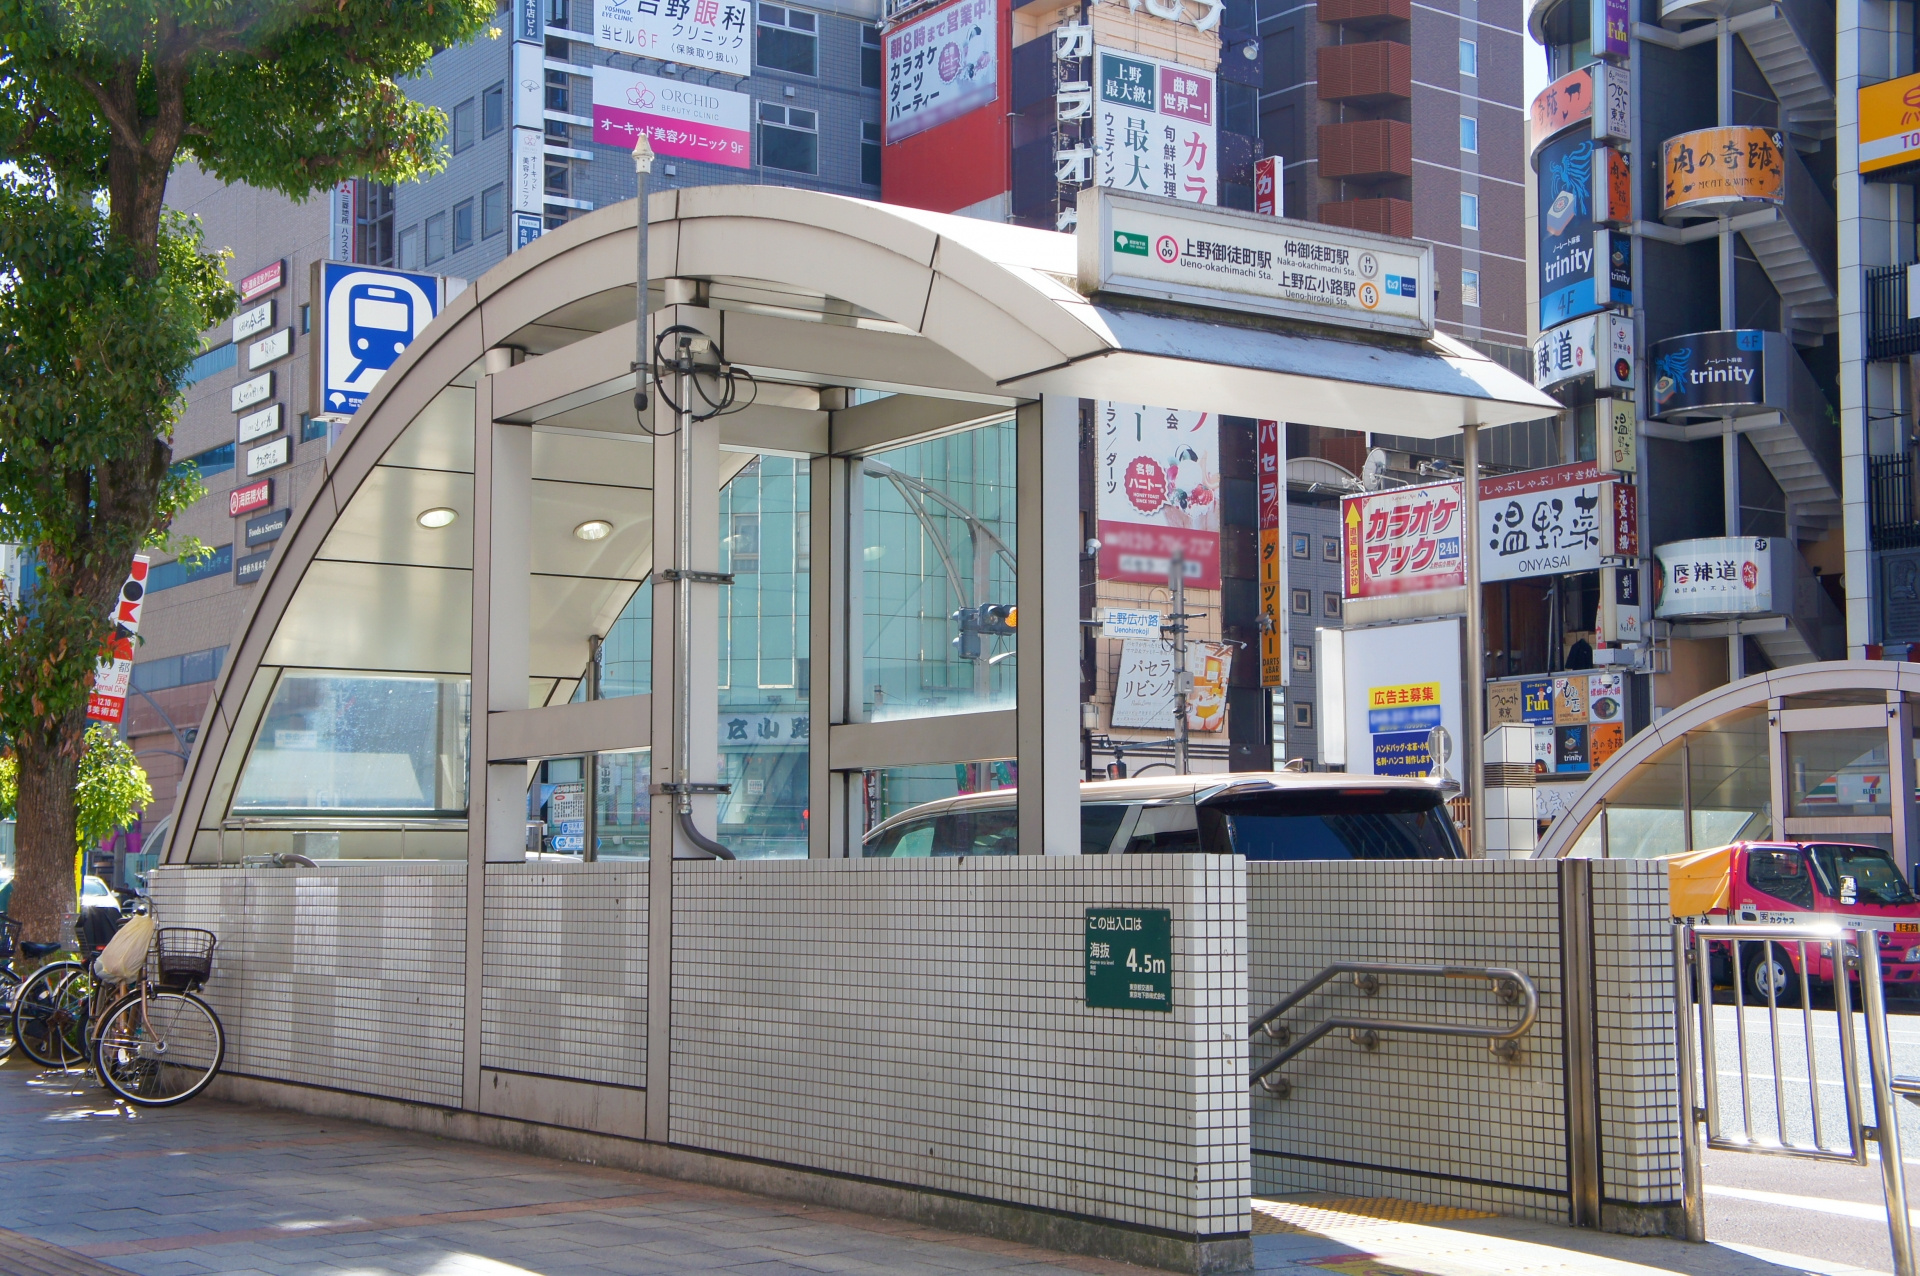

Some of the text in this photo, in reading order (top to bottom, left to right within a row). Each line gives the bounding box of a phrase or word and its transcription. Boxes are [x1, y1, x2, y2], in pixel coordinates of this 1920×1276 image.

[602, 10, 633, 23] EYE CLINIC
[604, 5, 631, 16] YOSHINO
[672, 22, 743, 49] クリニック
[1608, 21, 1628, 43] Fun
[890, 46, 937, 82] カラオケ
[1115, 63, 1142, 84] 上野
[1608, 69, 1616, 81] 6F
[890, 71, 924, 102] ダーツ
[1173, 76, 1199, 98] 曲数
[661, 88, 720, 110] ORCHID
[890, 91, 940, 122] パーティー
[661, 104, 720, 121] BEAUTY CLINIC
[1610, 108, 1626, 123] 東京
[601, 118, 744, 154] オーキッド美容クリニック 9F
[1772, 132, 1784, 150] 5F
[1163, 125, 1177, 199] 旬鮮料理
[522, 156, 530, 207] 美容クリニック
[1698, 177, 1755, 189] MEAT & WINE
[1165, 240, 1170, 248] E
[1161, 248, 1173, 258] 09
[1181, 238, 1272, 270] 上野御徒町駅
[1284, 240, 1350, 266] 仲御徒町駅
[1365, 257, 1371, 265] H
[1180, 258, 1274, 281] Ueno-okachimachi Sta.
[1277, 257, 1357, 277] Naka-okachimachi Sta.
[1364, 265, 1374, 274] 17
[1545, 248, 1594, 283] trinity
[1278, 270, 1356, 298] 上野広小路駅
[1610, 271, 1631, 286] trinity
[1285, 289, 1350, 307] Ueno-hirokoji Sta.
[1364, 295, 1374, 304] 15
[1365, 287, 1372, 295] G
[1557, 289, 1576, 317] 4F
[1741, 335, 1759, 348] 4F
[1690, 365, 1755, 385] trinity
[1135, 462, 1155, 477] 名物
[1260, 422, 1277, 503] パセラ
[1128, 478, 1163, 491] ハニトー
[248, 525, 262, 538] Foods
[265, 521, 283, 531] Services
[1365, 498, 1459, 544] カラオケ
[1489, 487, 1599, 557] 温野菜
[1440, 542, 1459, 556] 24h
[1756, 540, 1766, 550] 3F
[1350, 527, 1359, 587] 直進 徒歩30秒
[1366, 537, 1438, 578] マック
[1519, 555, 1571, 573] ONYASAI
[1105, 612, 1159, 627] 上野広小路
[1113, 626, 1150, 636] Uenohirokoji
[1126, 659, 1171, 677] パセラ
[1262, 657, 1280, 667] DARTS
[95, 683, 126, 696] ternal City
[1123, 679, 1175, 700] リビング
[1555, 680, 1565, 689] 8F
[1374, 686, 1434, 706] 広告主募集
[1525, 694, 1550, 712] Fun
[1498, 706, 1513, 719] 東京
[1376, 756, 1404, 767] 名刺・ハンコ
[1564, 754, 1582, 762] trinity
[1089, 916, 1143, 931] この出入口は
[1769, 916, 1795, 925] カクヤス
[1894, 923, 1919, 932] 高圧ガス
[1089, 942, 1166, 974] 海抜 4.5m
[1129, 983, 1154, 992] 東京都交通局
[1129, 991, 1166, 1001] 東京地下鉄株式会社
